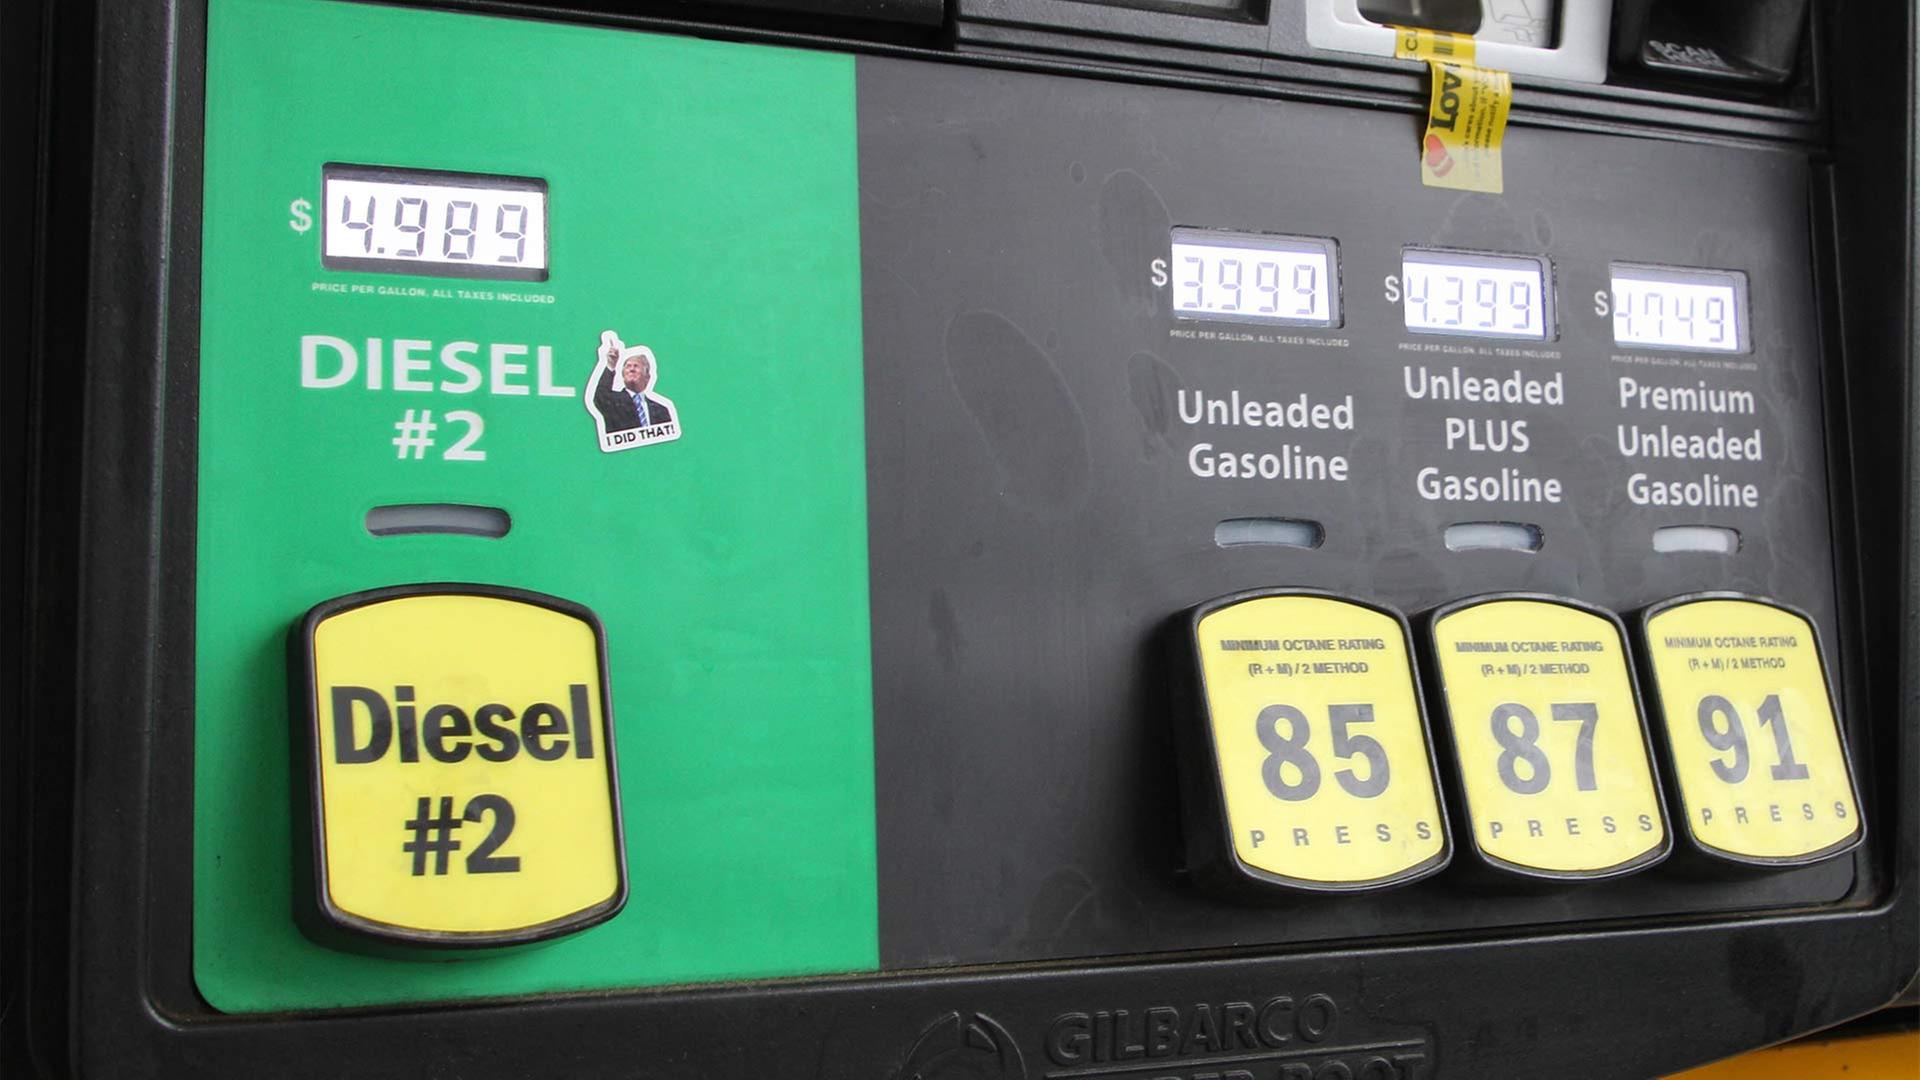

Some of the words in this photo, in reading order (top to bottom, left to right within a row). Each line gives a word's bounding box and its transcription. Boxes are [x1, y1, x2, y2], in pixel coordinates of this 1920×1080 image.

[289, 198, 312, 235] $
[341, 195, 528, 263] 4.989
[312, 282, 348, 293] PRICE
[351, 285, 375, 294] PER
[432, 288, 453, 298] ALL
[458, 290, 494, 300] TAXES
[497, 292, 555, 304] INCLUDED
[1151, 257, 1168, 287] $
[1182, 257, 1316, 314] 3.999
[1385, 274, 1400, 304] $
[1407, 275, 1530, 329] 4.399
[1612, 290, 1724, 342] 4.749
[1170, 329, 1195, 339] PRICE
[1199, 331, 1216, 340] PER
[1258, 334, 1275, 343] ALL
[1277, 335, 1303, 345] TAXES
[1306, 337, 1350, 347] INCLUDED
[1398, 343, 1422, 351] PRICE
[300, 334, 576, 398] DIESEL
[1404, 365, 1564, 405] Unleaded
[1618, 376, 1755, 414] Premium
[1178, 389, 1354, 430] Unleaded
[392, 409, 487, 461] #2
[606, 436, 611, 446] I
[614, 432, 636, 445] DID
[638, 424, 675, 439] THAT!
[1446, 417, 1530, 452] PLUS
[1617, 425, 1762, 461] Unleaded
[1188, 442, 1349, 481] Gasoline
[1417, 466, 1562, 503] Gasoline
[1627, 473, 1758, 507] Gasoline
[1221, 639, 1280, 651] MINIMUM
[1283, 639, 1335, 651] OCTANE
[1338, 638, 1385, 650] RATING
[1455, 642, 1509, 652] MINIMUM
[1511, 642, 1559, 652] OCTANE
[1562, 641, 1604, 652] RATING
[1664, 636, 1712, 648] MINIMUM
[1714, 636, 1757, 648] OCTANE
[1760, 636, 1797, 648] RATING
[1313, 662, 1368, 674] METHOD
[1540, 663, 1589, 674] METHOD
[1741, 657, 1785, 669] METHOD
[331, 684, 594, 765] Diesel
[1697, 694, 1810, 784] 91
[1256, 703, 1390, 801] 85
[1490, 702, 1599, 795] 87
[1490, 814, 1652, 839] PRESS
[1701, 801, 1846, 825] PRESS
[403, 793, 521, 876] #2
[1250, 822, 1431, 848] PRESS
[1046, 994, 1338, 1066] GILBARCO
